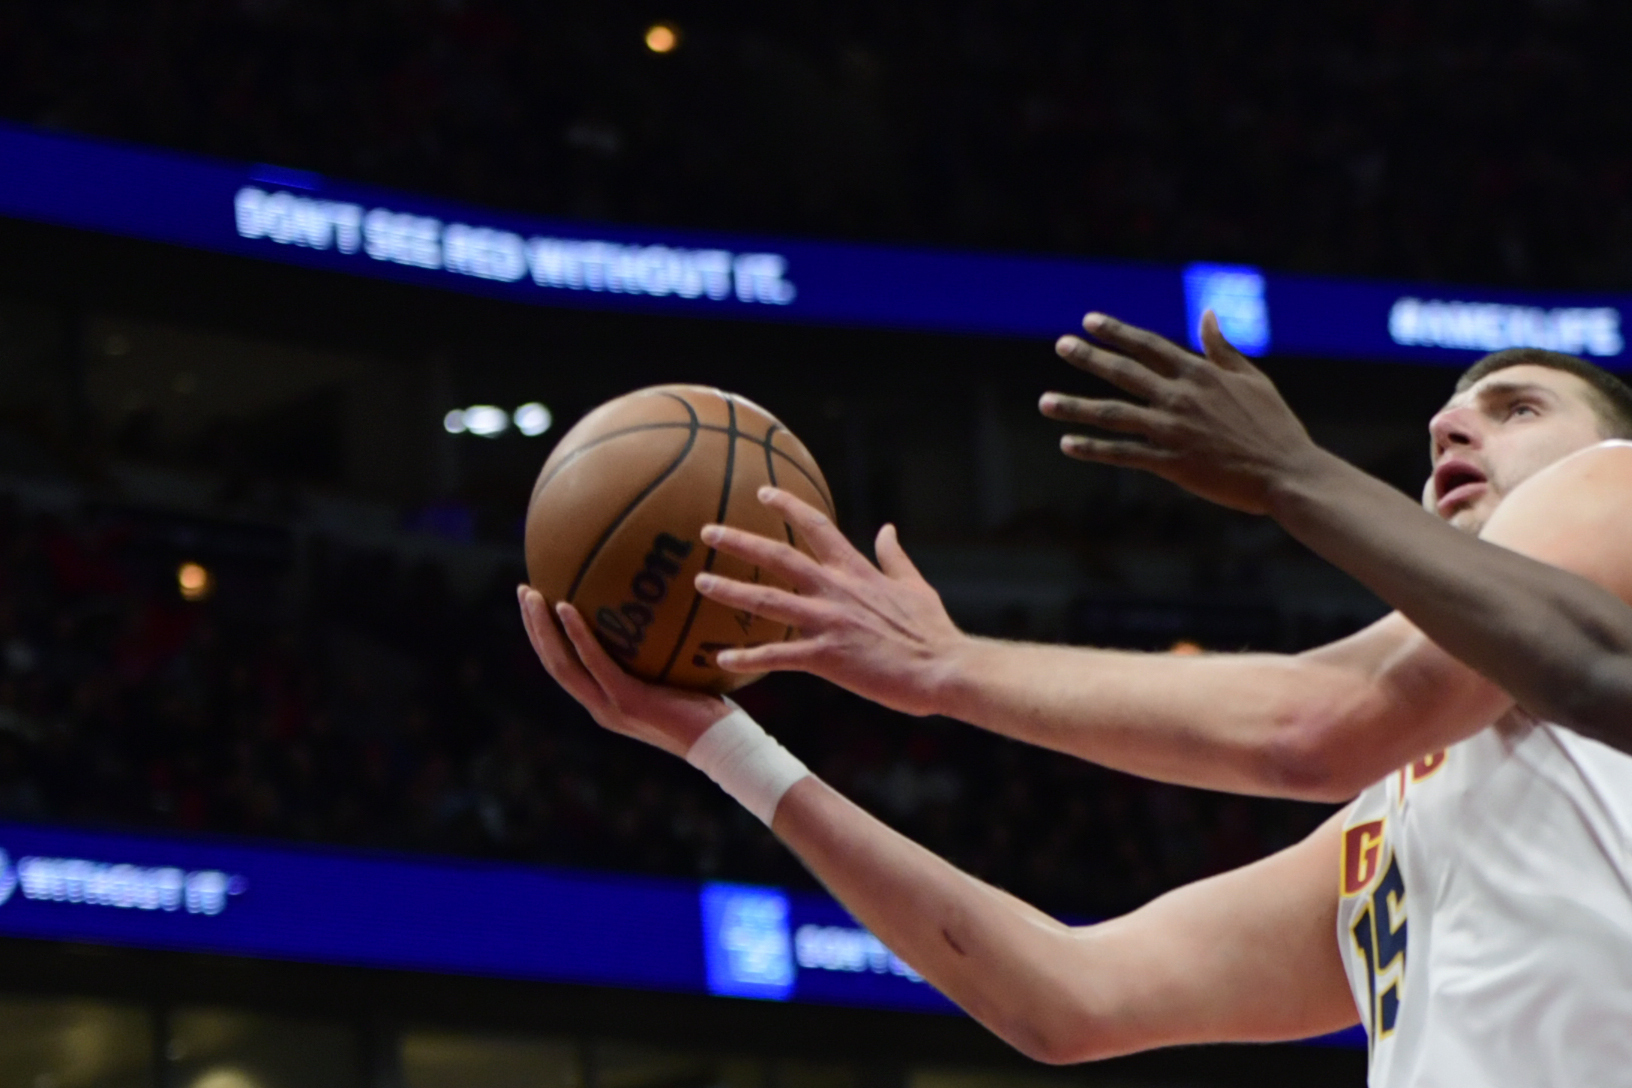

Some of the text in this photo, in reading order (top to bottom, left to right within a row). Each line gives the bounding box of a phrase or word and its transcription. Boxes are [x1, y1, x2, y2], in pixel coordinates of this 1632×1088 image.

[364, 207, 443, 270] SEE
[443, 222, 524, 283] RED
[523, 235, 734, 300] WITHOUT
[17, 855, 185, 912] WITHOUT
